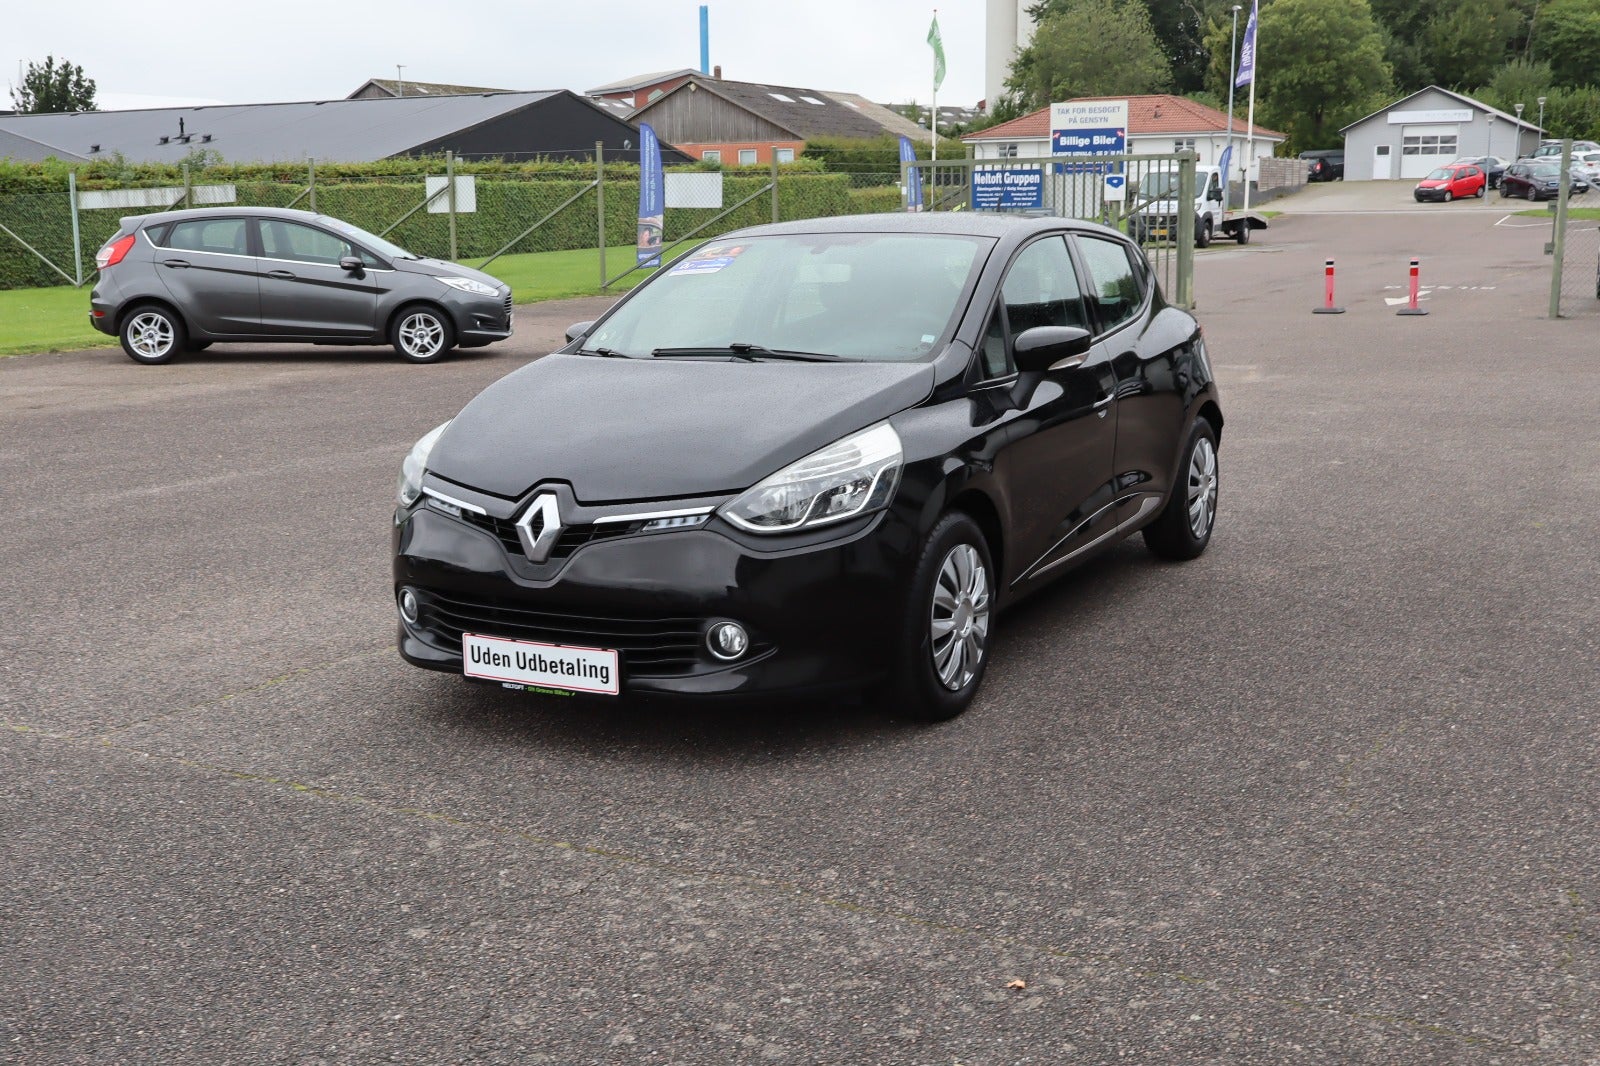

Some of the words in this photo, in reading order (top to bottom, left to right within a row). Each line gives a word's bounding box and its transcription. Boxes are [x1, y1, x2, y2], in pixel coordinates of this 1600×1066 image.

[1088, 106, 1121, 114] BESØGET
[1080, 116, 1109, 124] GENSYN
[1059, 136, 1090, 147] Billige
[1093, 135, 1117, 145] Biler
[974, 172, 1003, 184] Neltoft
[1003, 172, 1040, 186] Gruppen
[470, 645, 511, 668] Uden
[516, 651, 610, 684] Udbetaling
